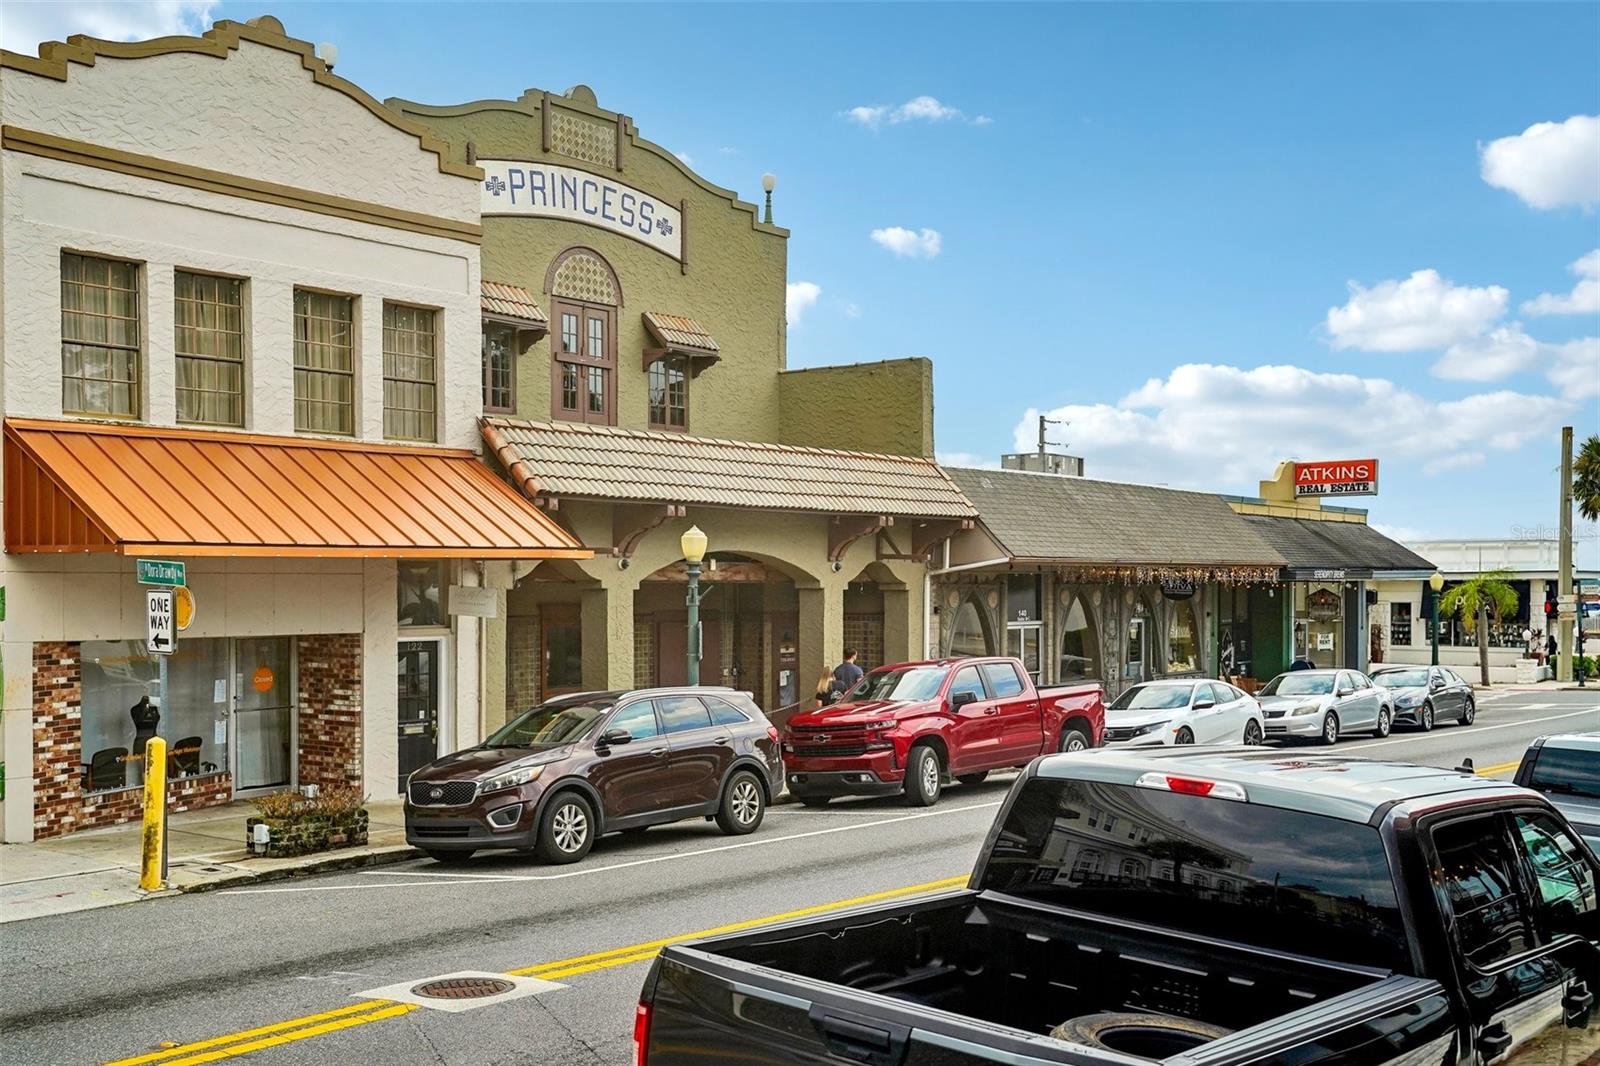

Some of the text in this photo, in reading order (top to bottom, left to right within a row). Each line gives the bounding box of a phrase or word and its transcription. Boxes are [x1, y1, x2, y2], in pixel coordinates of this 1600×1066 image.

[508, 168, 655, 235] PRINCESS
[1299, 465, 1369, 481] ATKINS
[1299, 482, 1369, 494] REAL ESTATE
[148, 563, 159, 578] Dora
[159, 565, 177, 583] Drawdy
[150, 598, 169, 612] ONE
[150, 616, 170, 629] WAY
